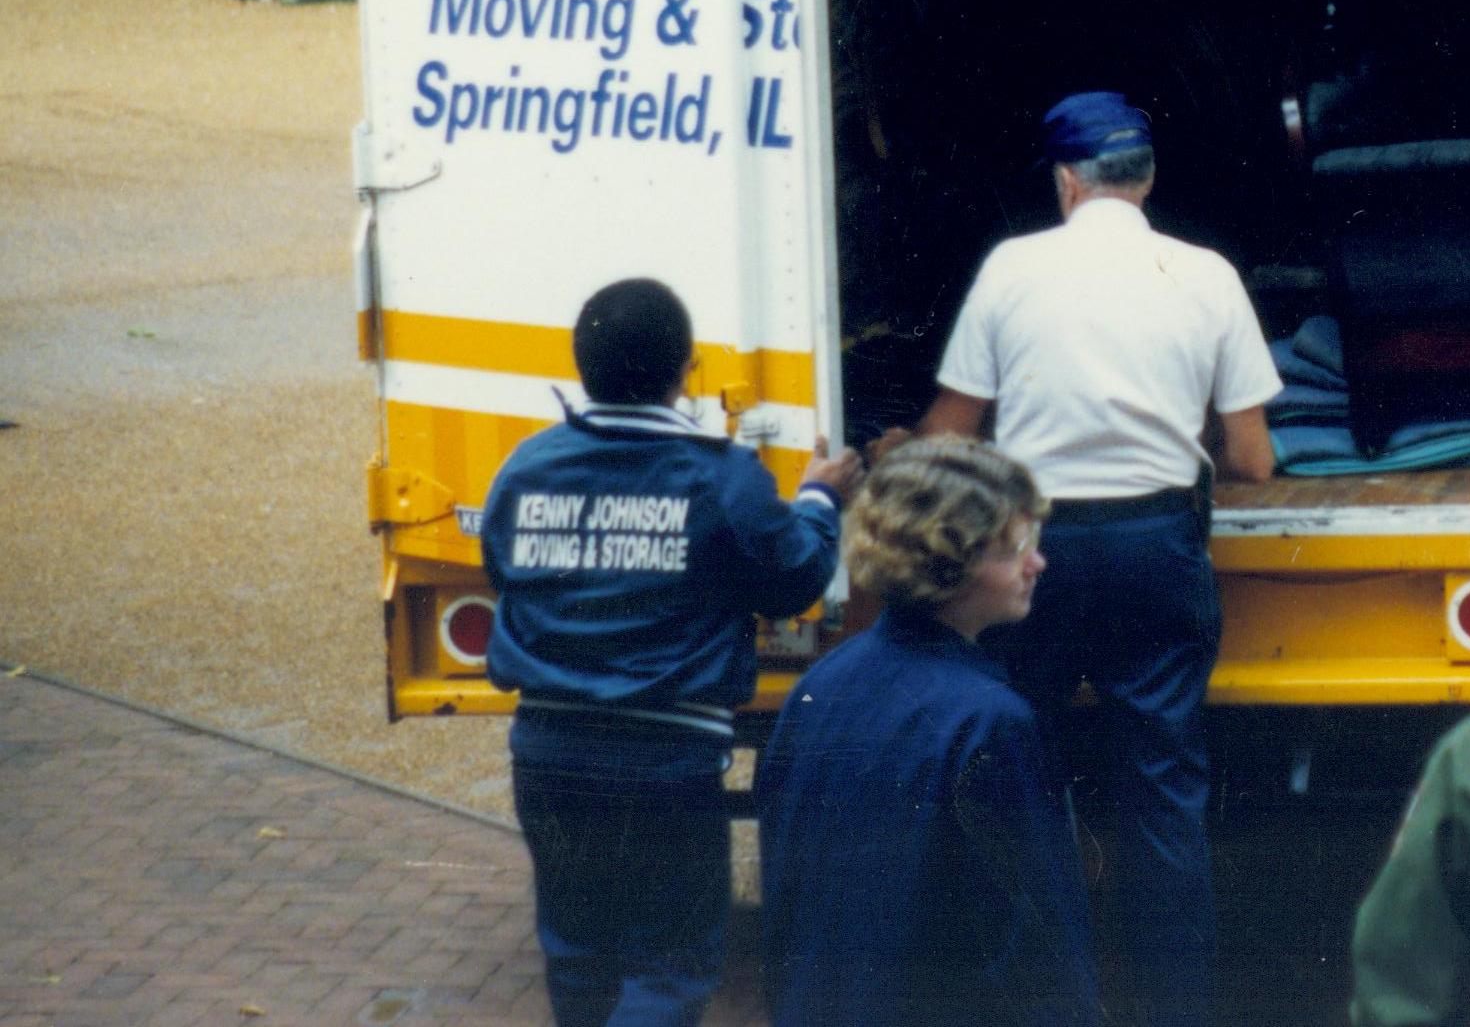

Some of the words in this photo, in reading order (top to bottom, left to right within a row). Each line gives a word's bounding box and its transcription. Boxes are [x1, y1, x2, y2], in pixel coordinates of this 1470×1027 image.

[413, 61, 722, 155] Springfield,
[745, 77, 793, 149] IL
[516, 494, 585, 529] KENNY
[587, 495, 689, 532] JOHNSON
[512, 533, 580, 569] MOVING
[582, 535, 597, 569] &
[601, 535, 689, 571] STORAGE
